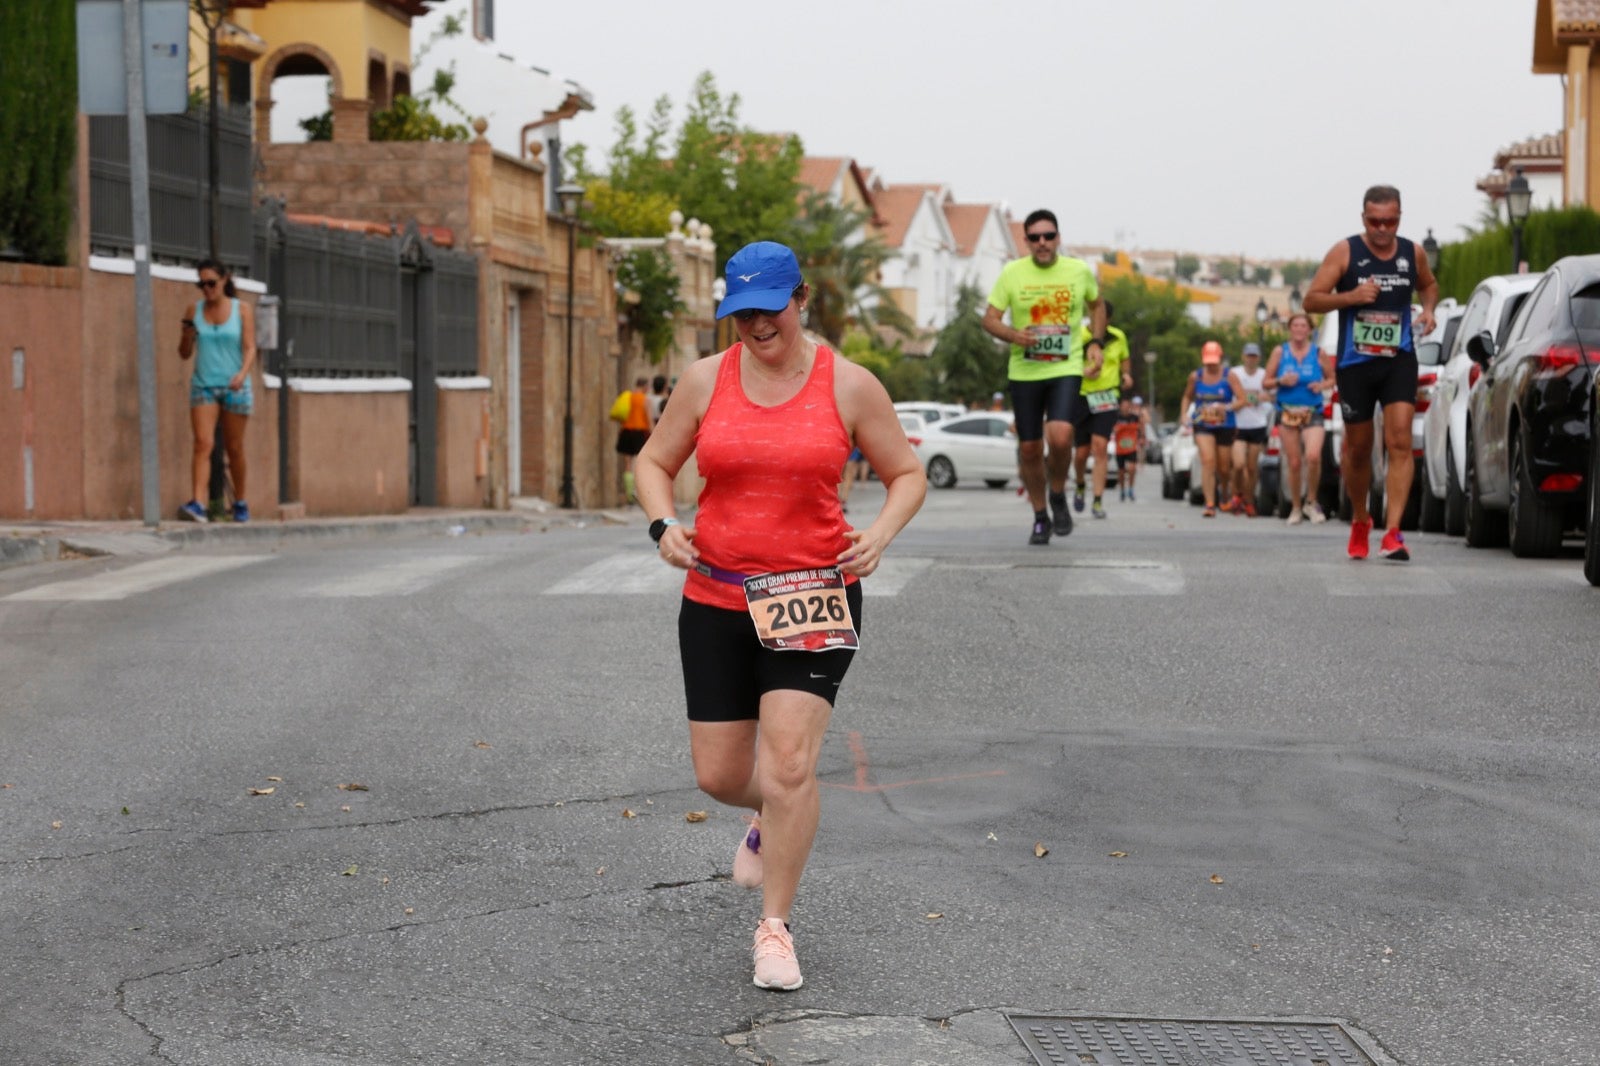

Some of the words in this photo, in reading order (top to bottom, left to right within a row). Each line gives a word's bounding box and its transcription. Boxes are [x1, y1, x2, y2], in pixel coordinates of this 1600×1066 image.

[1362, 325, 1394, 343] 709
[768, 574, 786, 587] GRAN
[786, 570, 810, 584] PREMIO
[810, 569, 818, 580] DE
[767, 595, 845, 631] 2026
